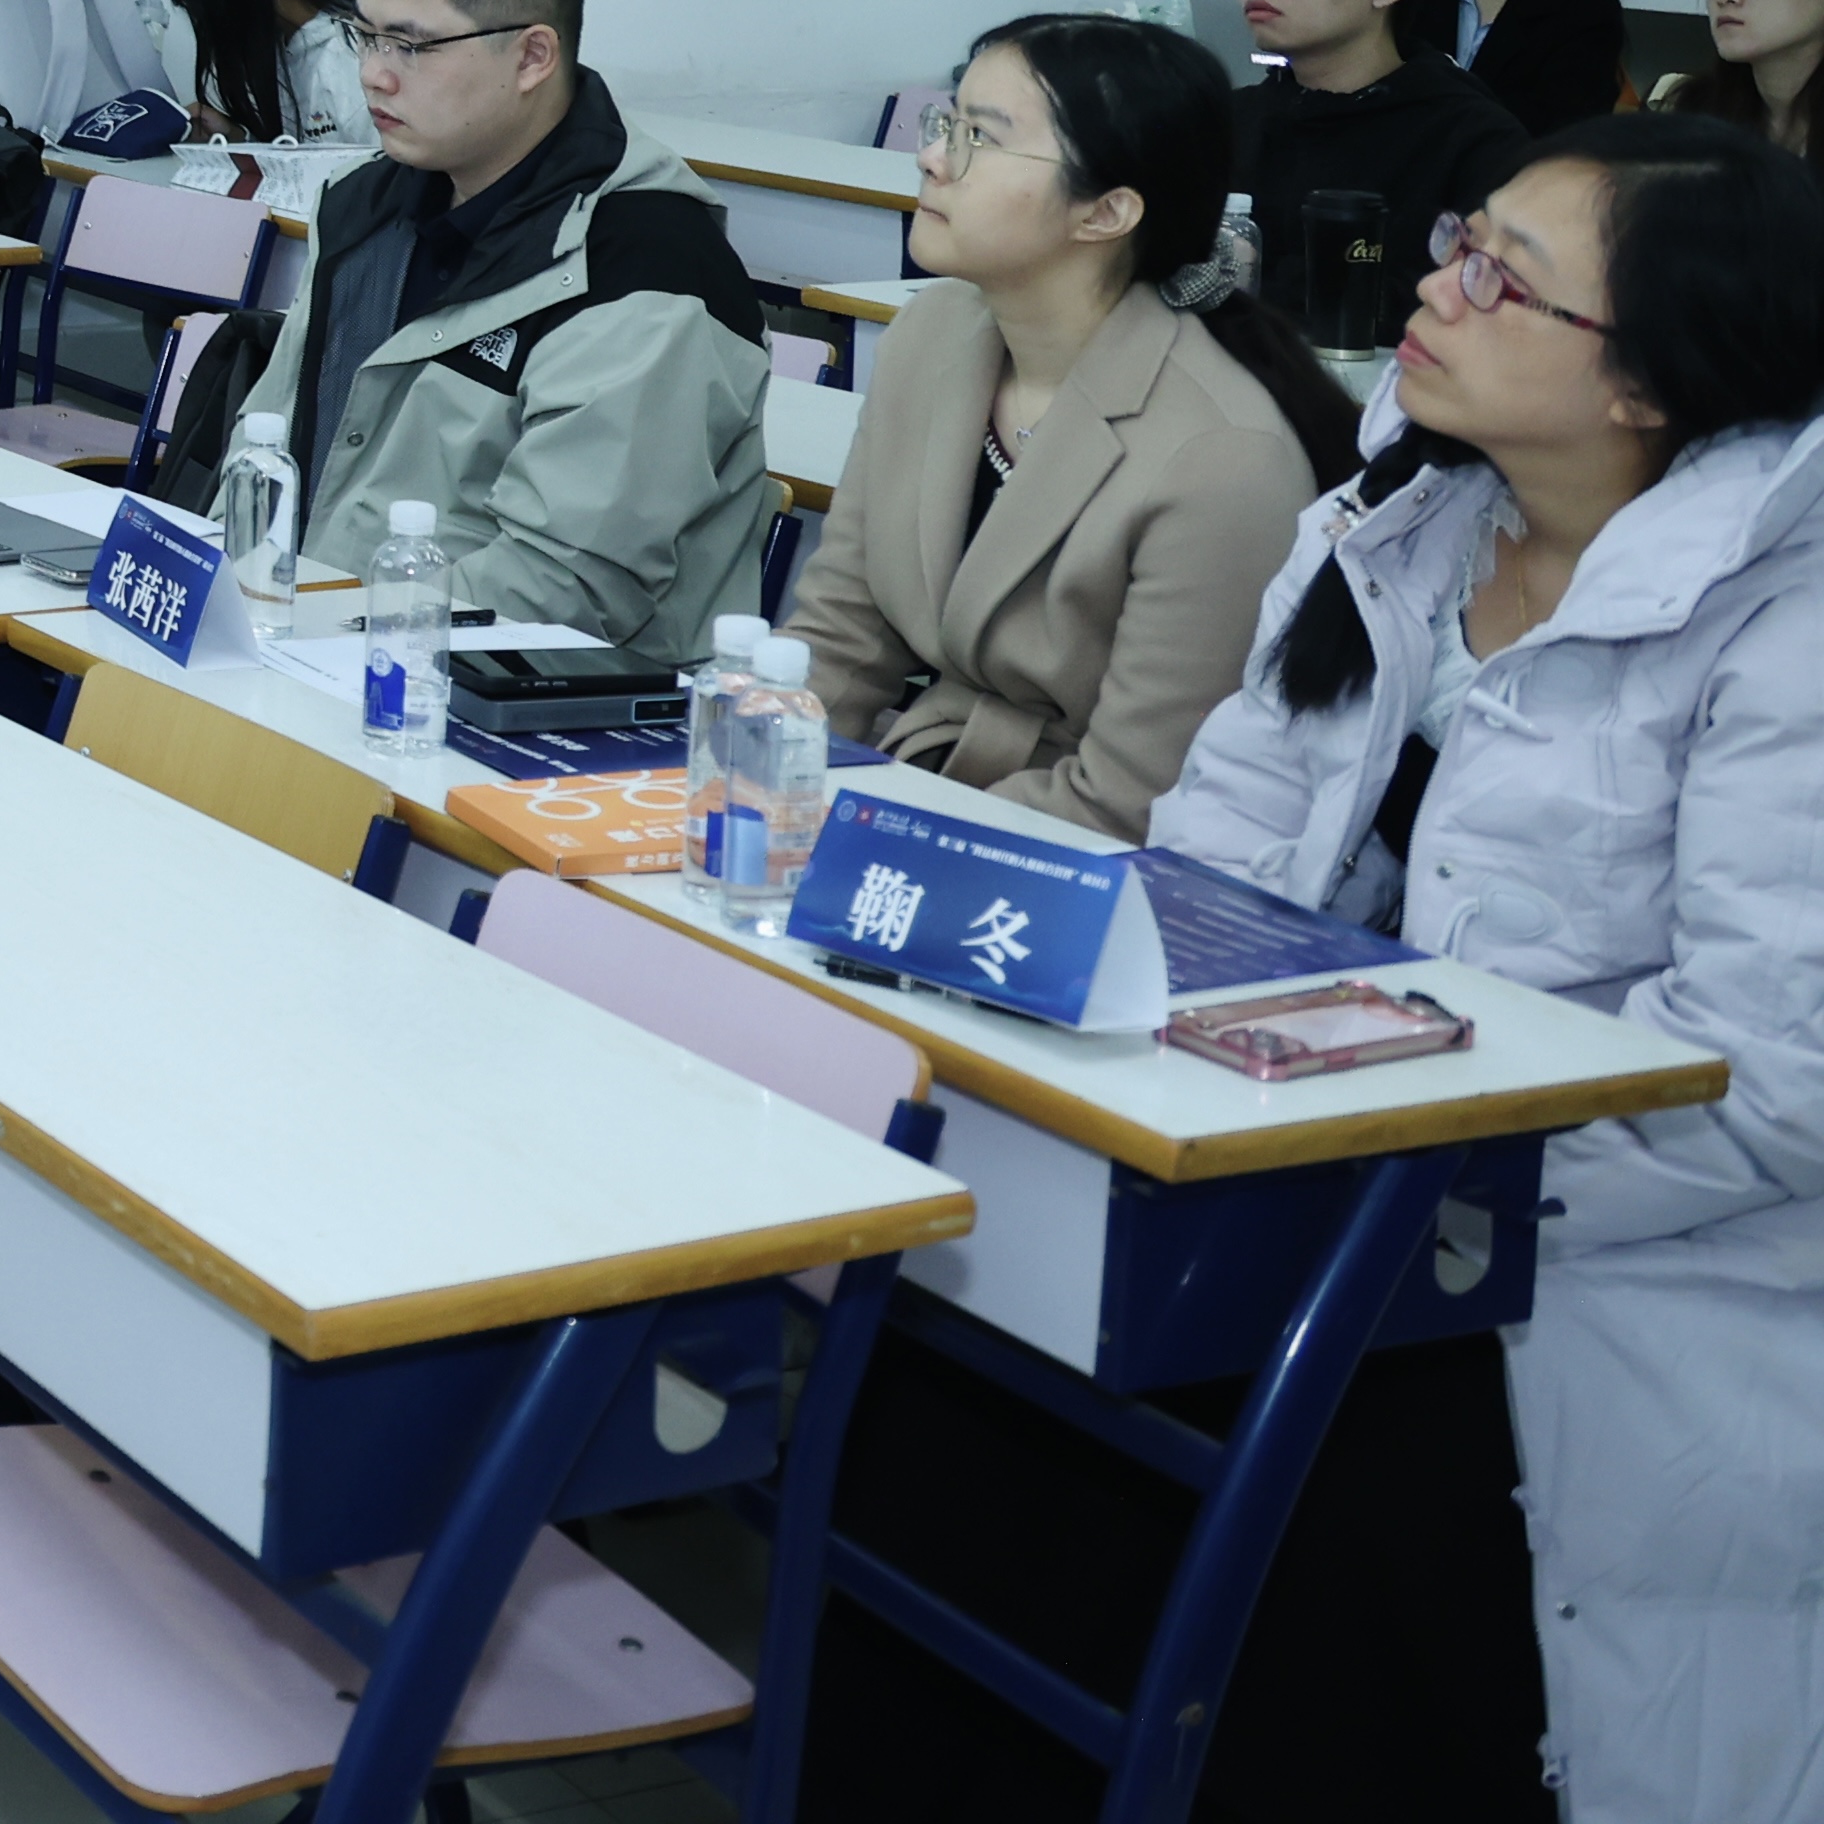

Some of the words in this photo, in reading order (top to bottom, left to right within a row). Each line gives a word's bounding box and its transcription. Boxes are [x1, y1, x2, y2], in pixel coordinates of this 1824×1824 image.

[468, 342, 502, 365] FACE
[104, 549, 188, 642] 张茜洋
